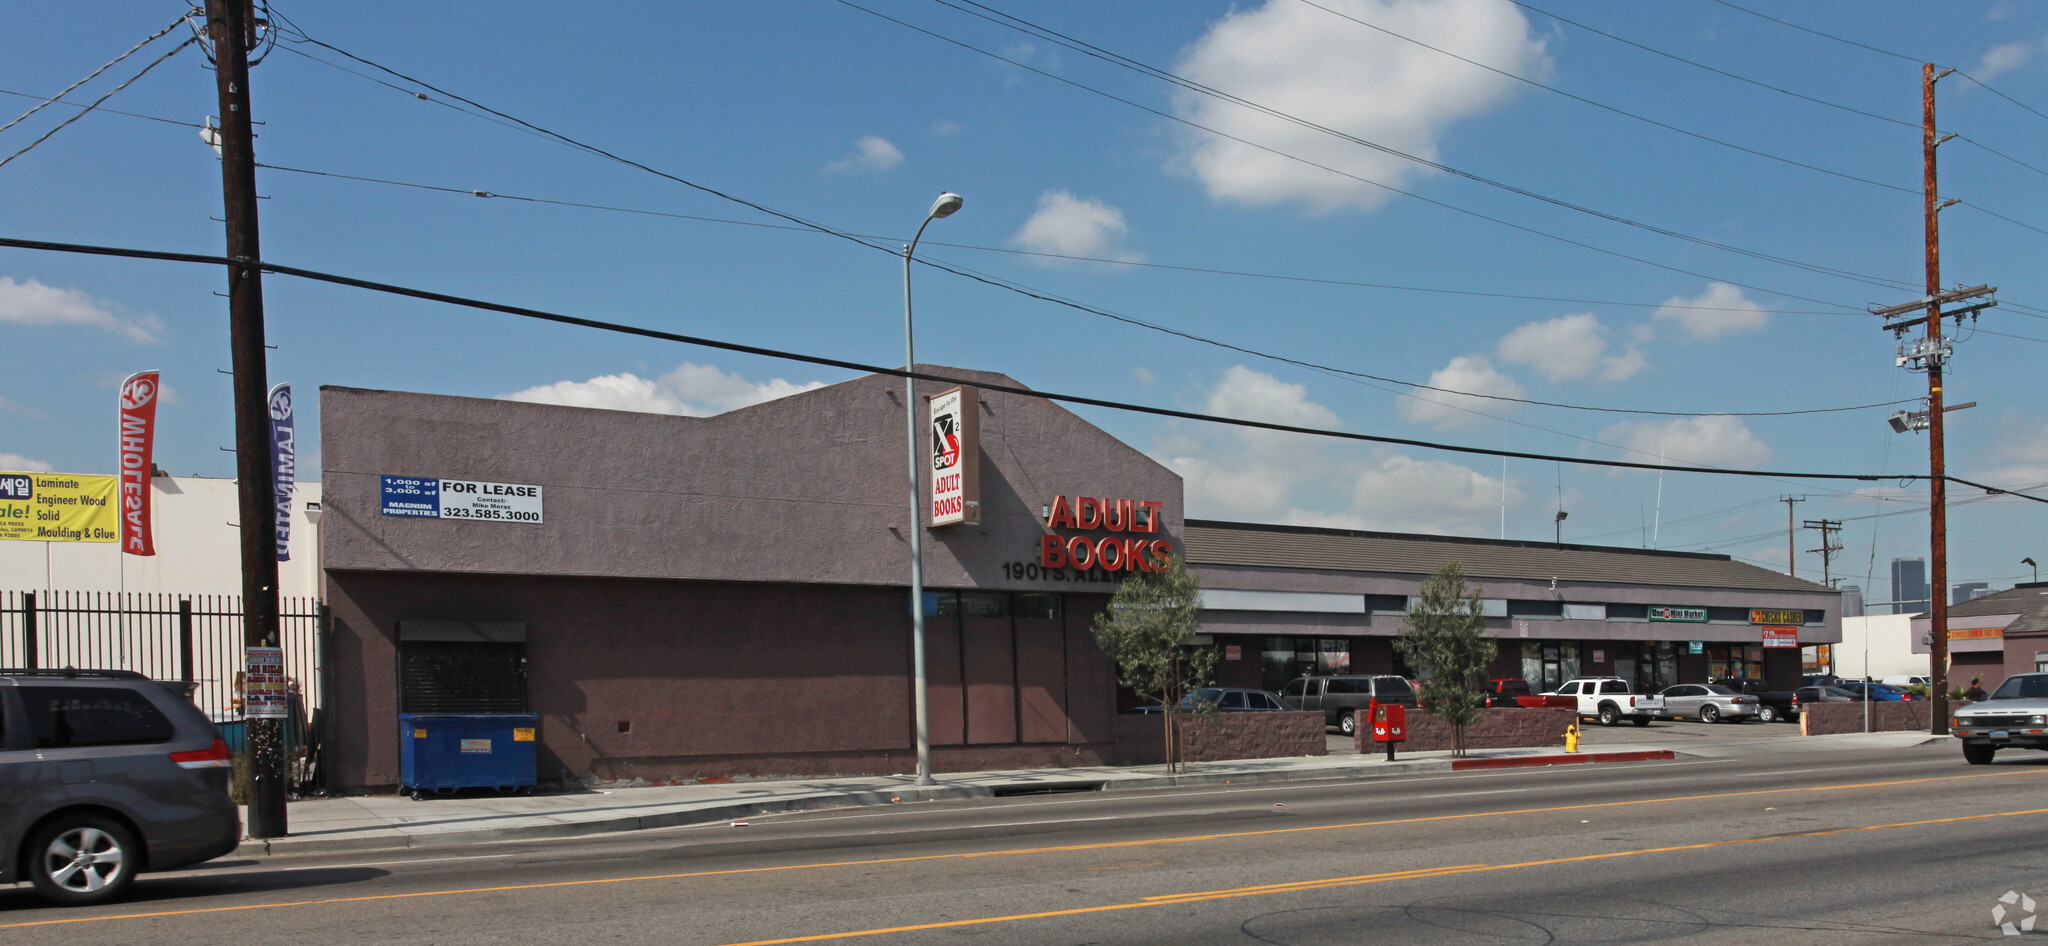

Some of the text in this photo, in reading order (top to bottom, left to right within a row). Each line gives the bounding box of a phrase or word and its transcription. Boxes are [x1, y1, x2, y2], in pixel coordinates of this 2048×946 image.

[933, 417, 955, 456] X
[935, 453, 955, 468] SPOT
[0, 478, 29, 497] 세일
[36, 477, 79, 489] Laminate
[442, 482, 538, 498] FOR LEASE
[935, 473, 960, 495] ADULT
[385, 487, 421, 495] 3,000
[37, 493, 106, 507] Engineer Wood
[388, 502, 432, 510] MAGNUM
[934, 496, 962, 517] BOOKS
[37, 510, 60, 521] Solid
[383, 508, 438, 517] PROPERTIES
[444, 507, 539, 521] 323.585.3000
[1047, 495, 1164, 532] ADULT
[37, 526, 115, 541] Moulding & Glue
[1041, 535, 1172, 573] BOOKS
[1003, 562, 1048, 581] 1901
[1652, 609, 1664, 617] One
[1671, 610, 1683, 618] Mini
[1684, 610, 1703, 619] Market
[1762, 610, 1781, 623] CHECKS
[1783, 611, 1802, 623] CASHED
